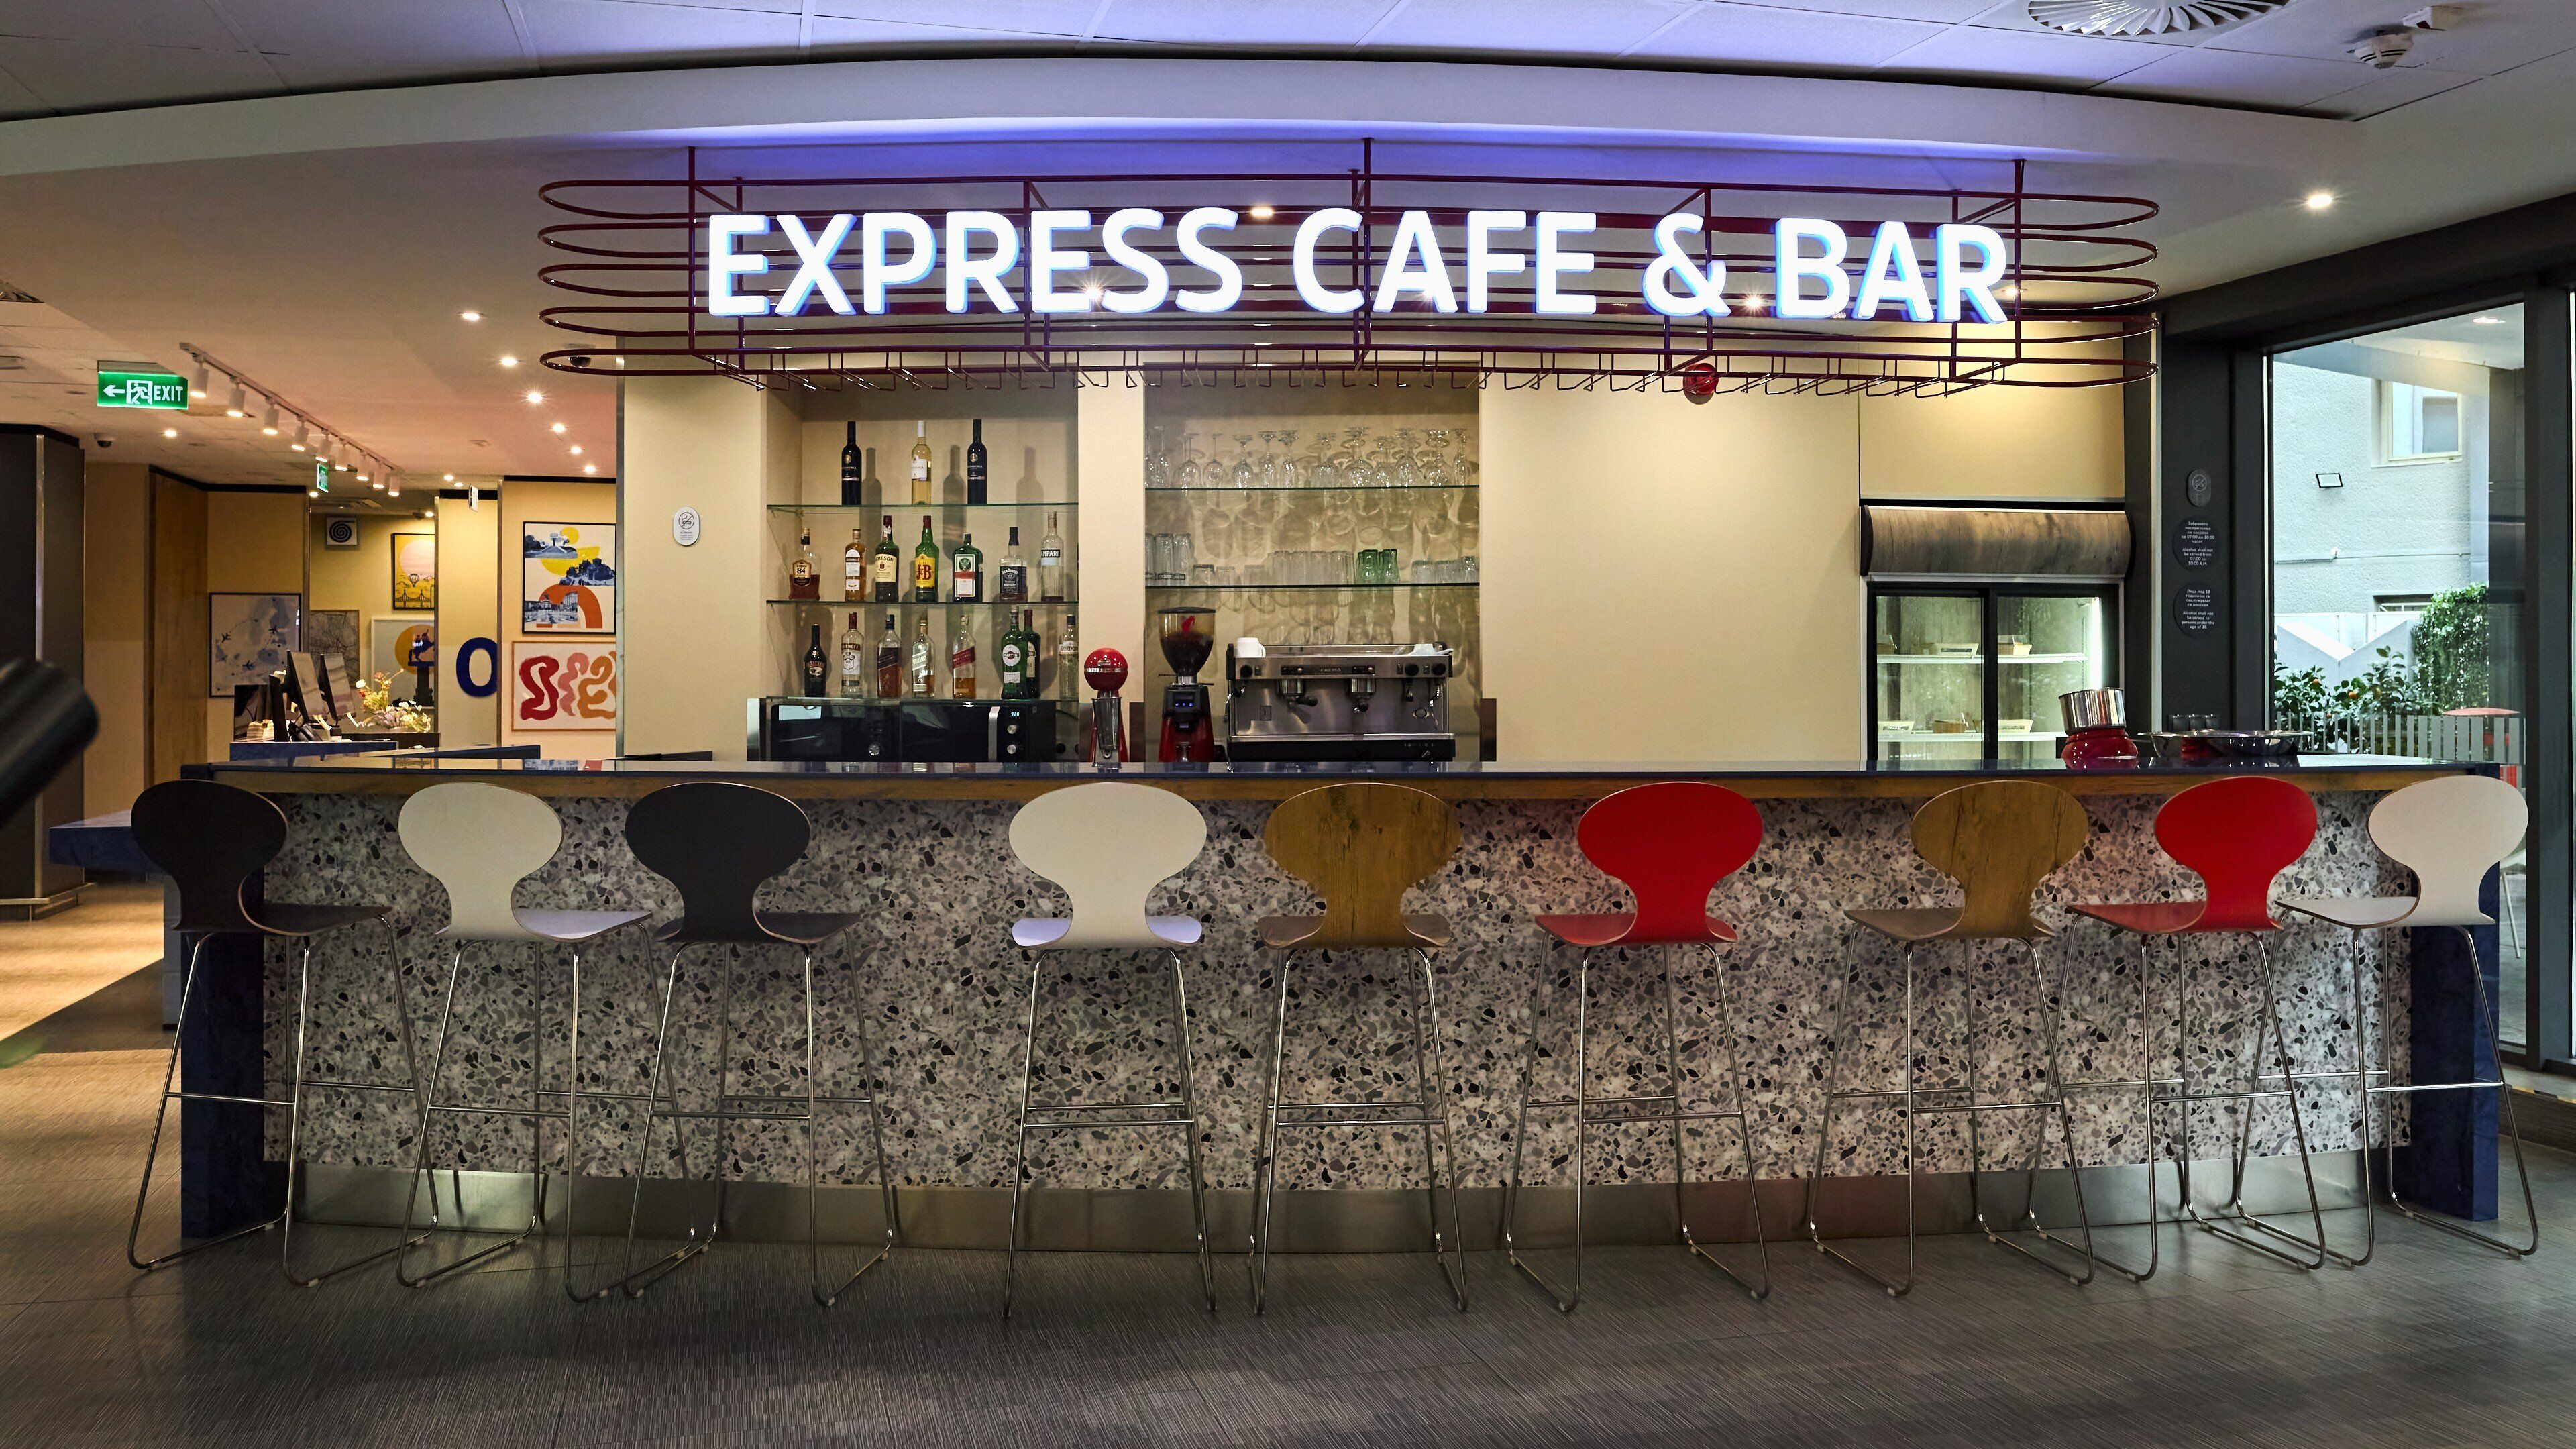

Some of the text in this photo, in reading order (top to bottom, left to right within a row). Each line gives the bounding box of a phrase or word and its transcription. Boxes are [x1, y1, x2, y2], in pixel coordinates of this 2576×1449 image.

[708, 207, 2009, 324] EXPRESS CAFE & BAR
[154, 385, 184, 402] EXIT
